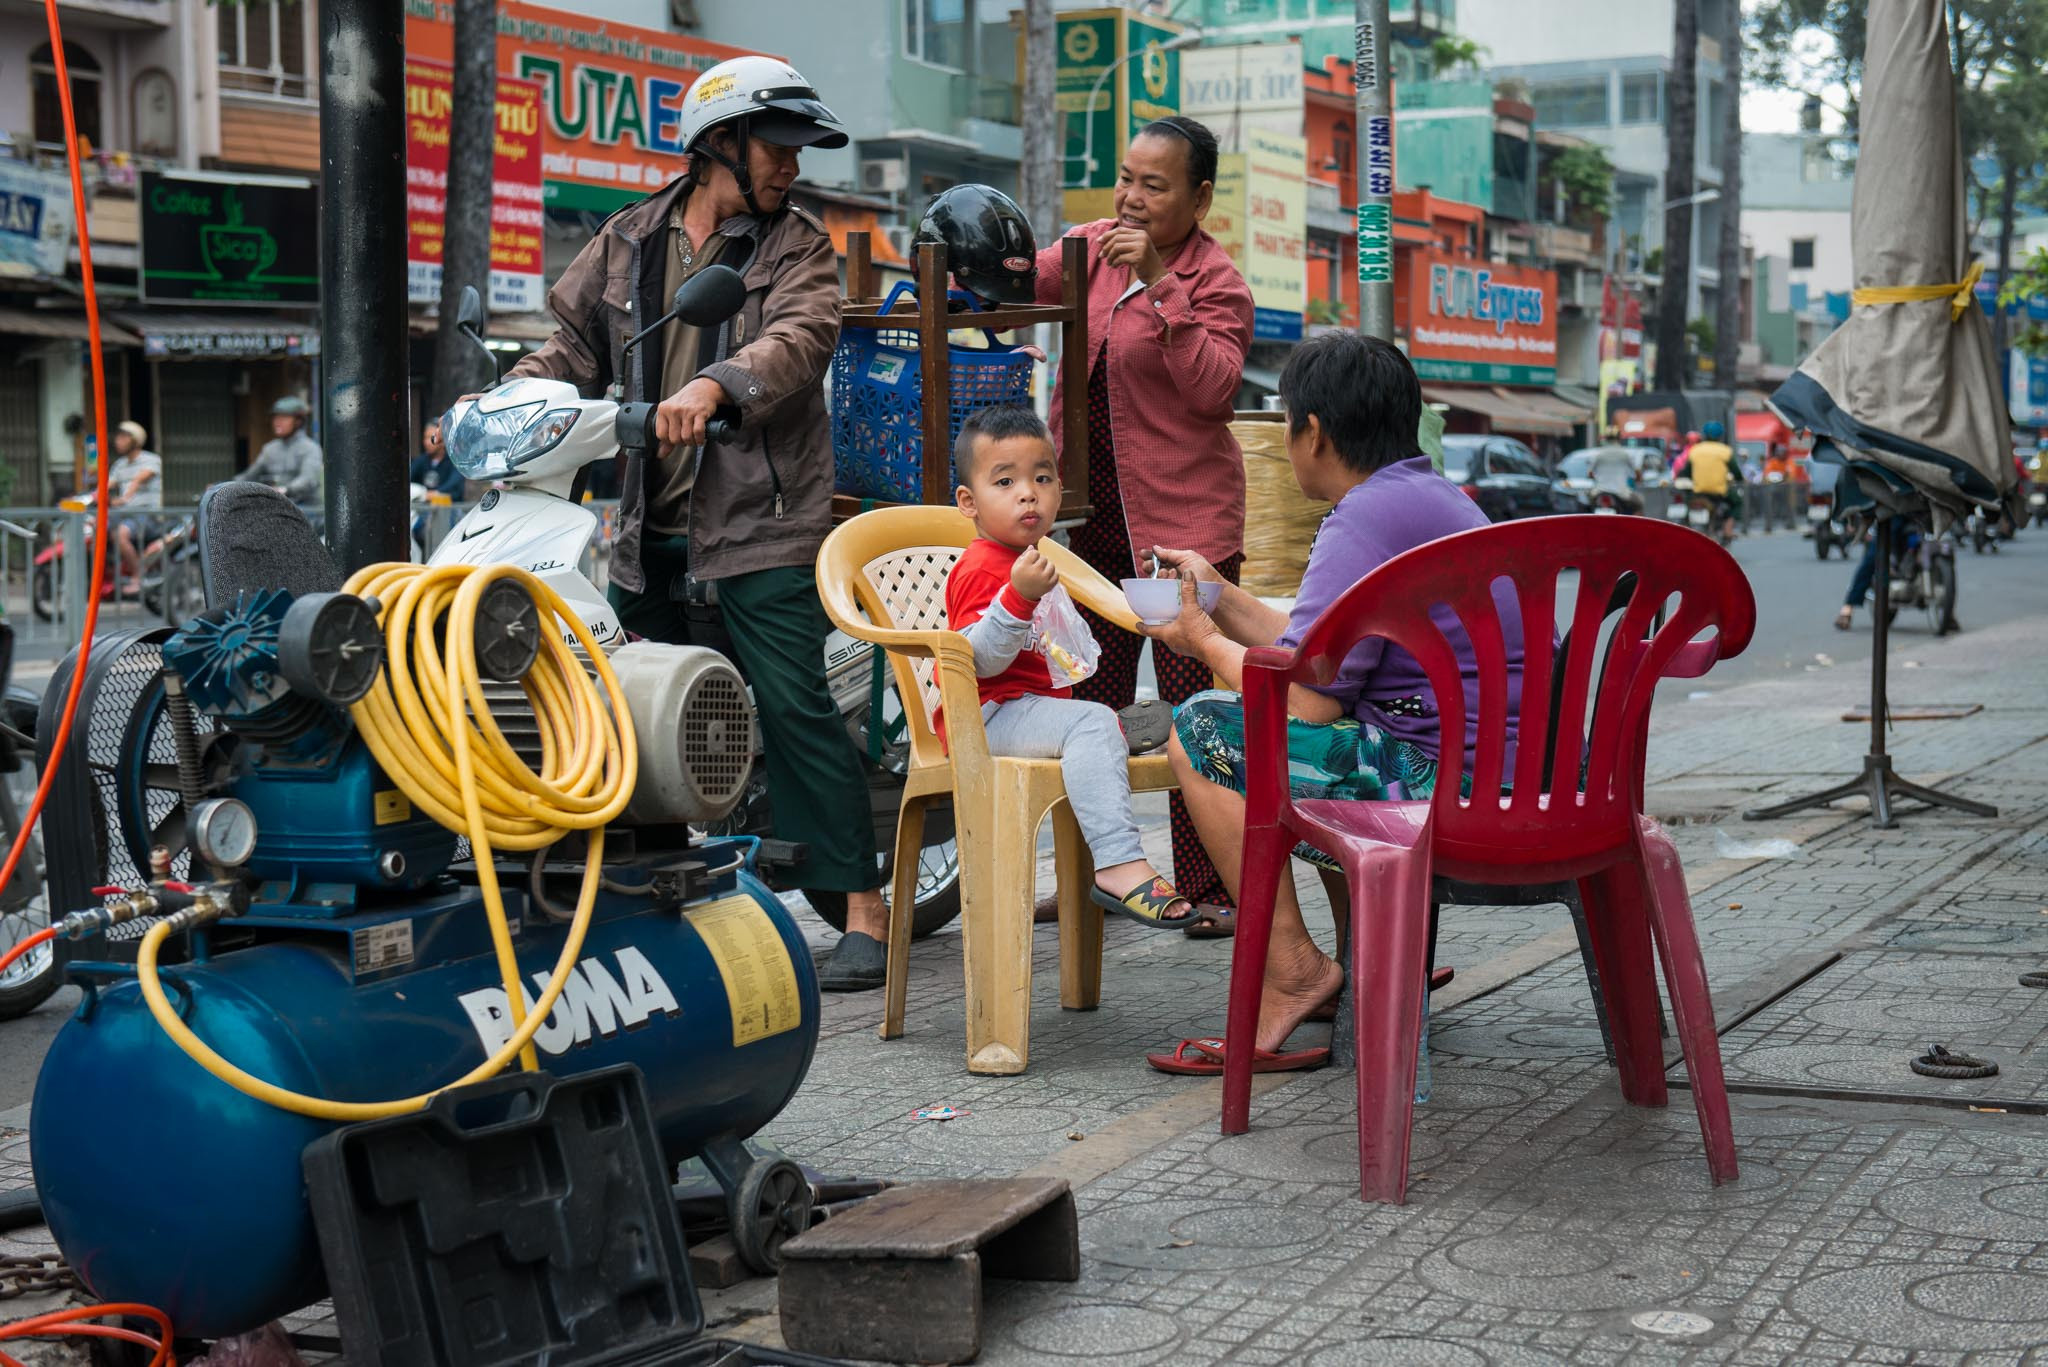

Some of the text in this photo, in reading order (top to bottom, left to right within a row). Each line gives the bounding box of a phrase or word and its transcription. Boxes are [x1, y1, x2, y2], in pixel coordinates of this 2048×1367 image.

[1358, 204, 1389, 282] 0902 30 30 58
[458, 946, 681, 1060] PUMA
